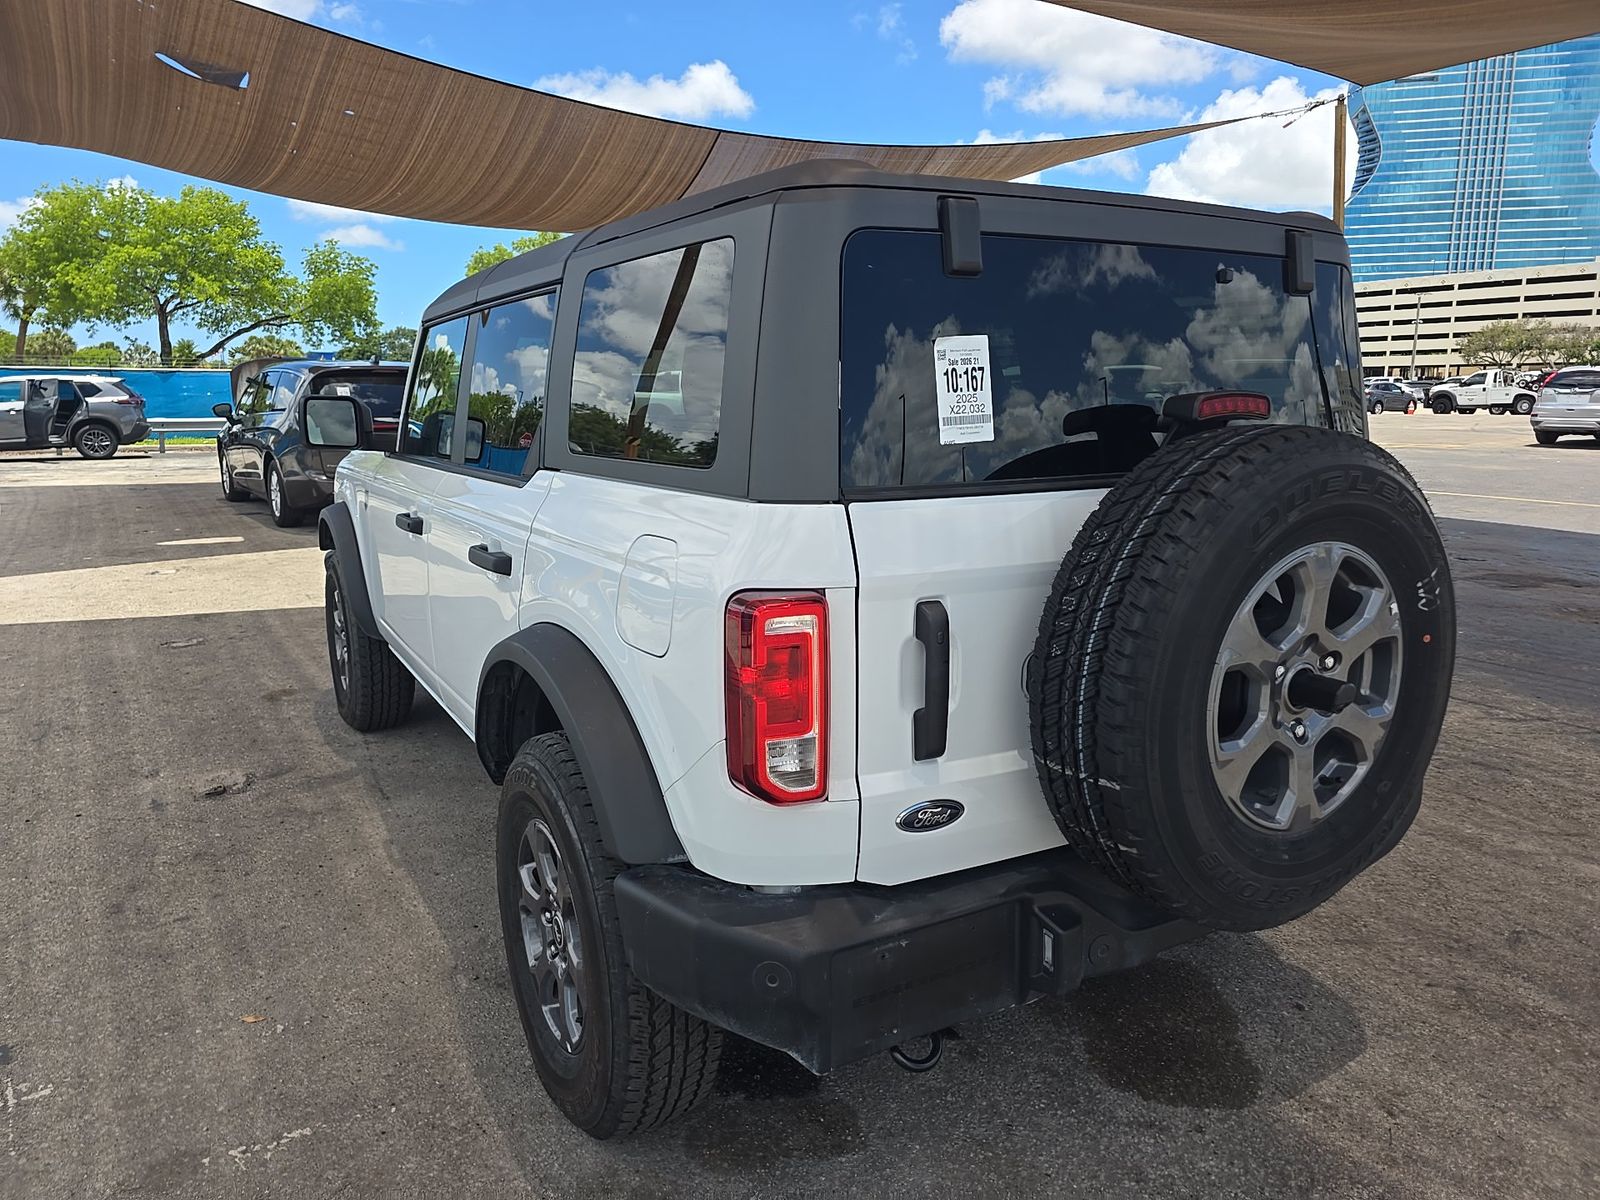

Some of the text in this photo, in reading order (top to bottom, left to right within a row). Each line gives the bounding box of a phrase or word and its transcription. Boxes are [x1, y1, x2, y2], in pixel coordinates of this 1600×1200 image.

[948, 358, 959, 366] Sale
[960, 357, 972, 366] 2026
[943, 366, 985, 393] 10:167
[955, 393, 978, 404] 2025
[949, 403, 986, 415] X22,032
[1250, 470, 1422, 546] DUELER
[914, 807, 951, 827] Ford
